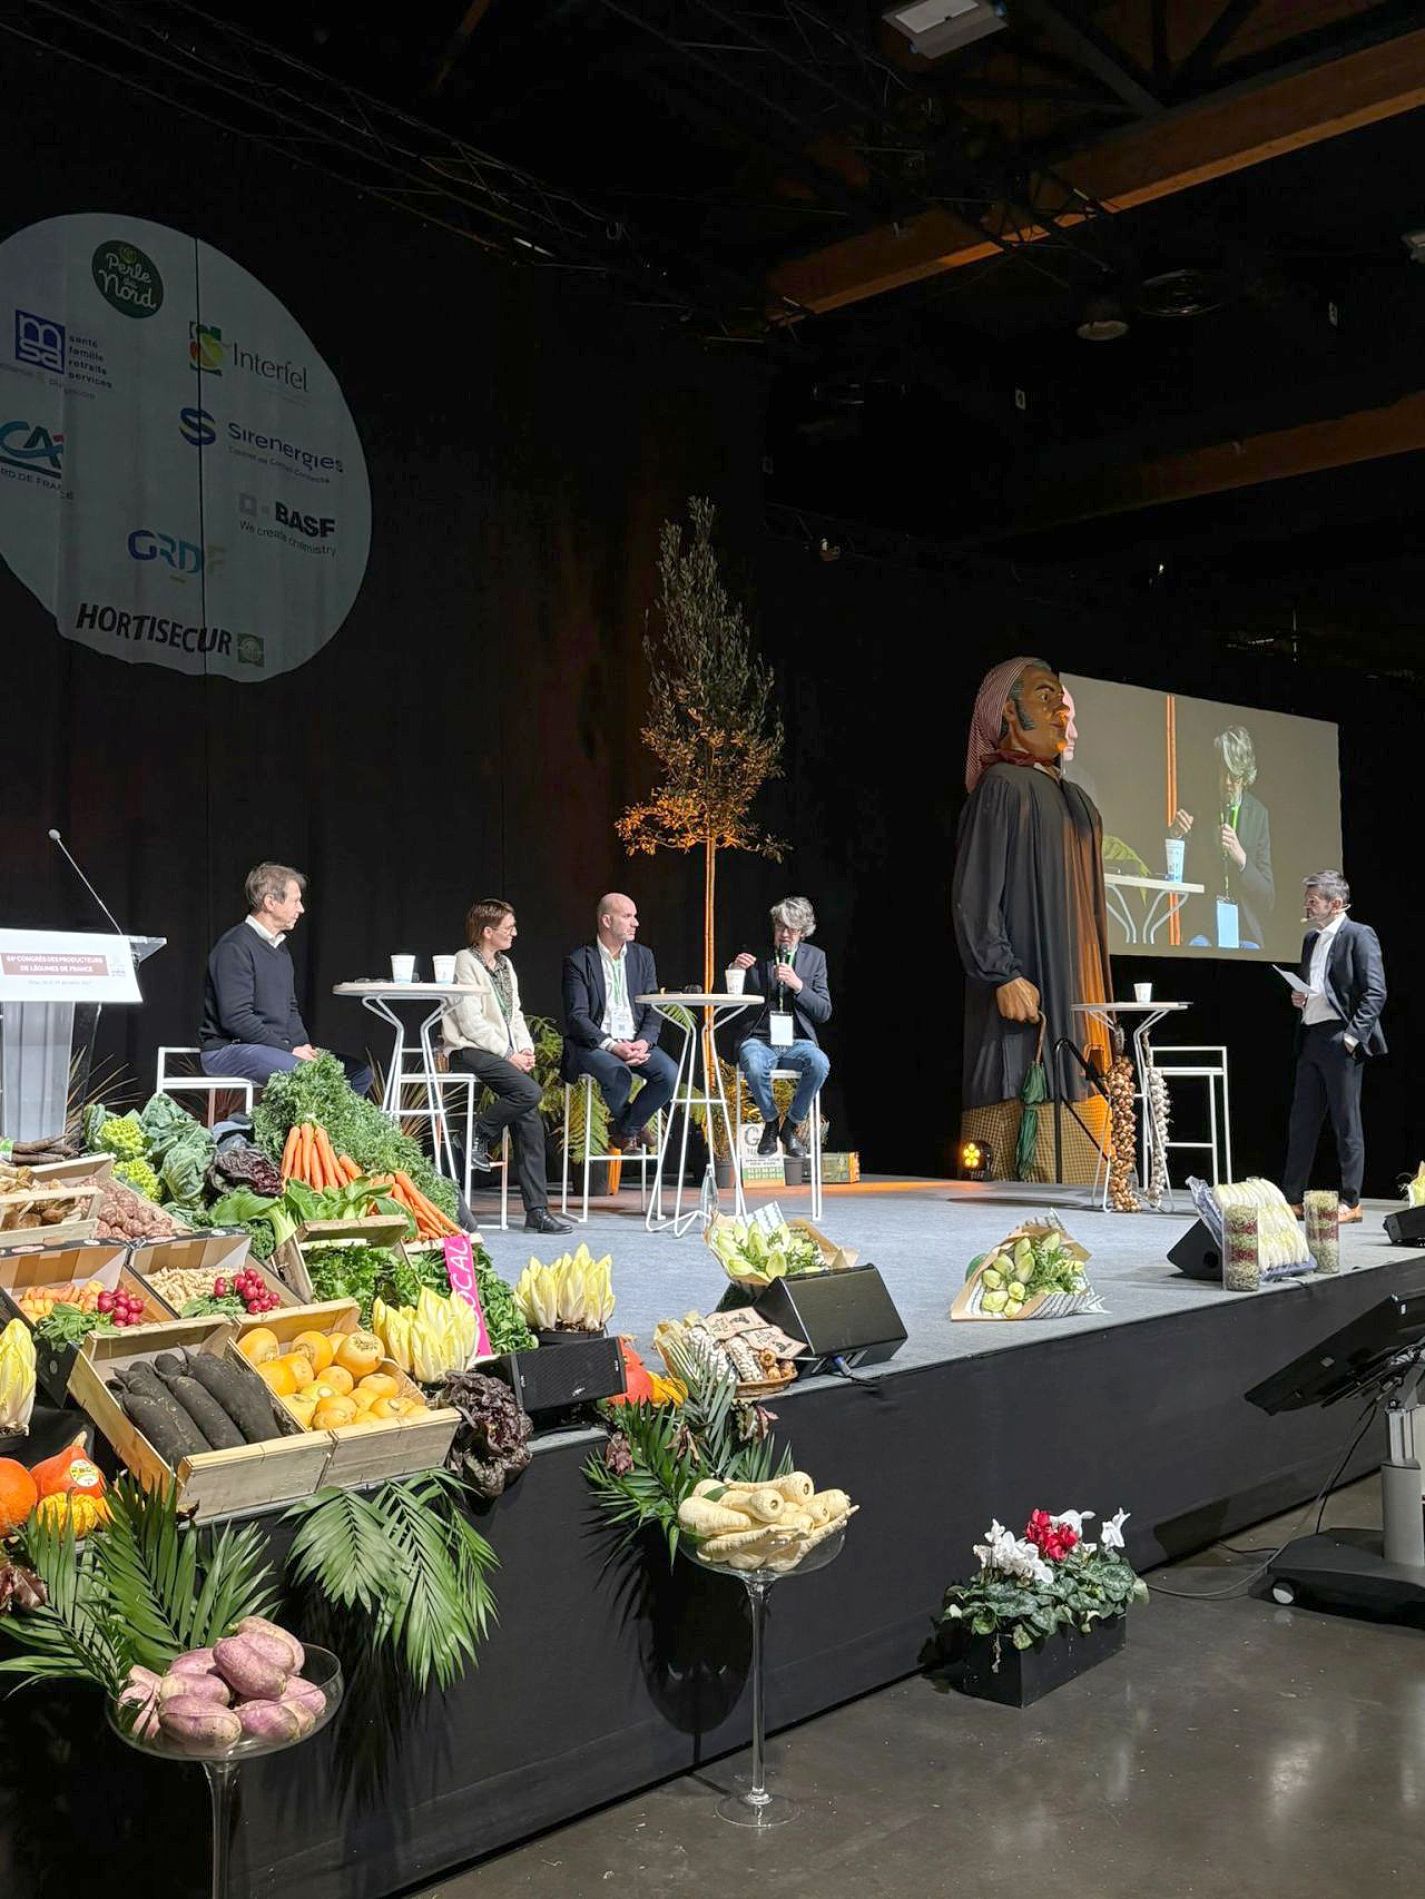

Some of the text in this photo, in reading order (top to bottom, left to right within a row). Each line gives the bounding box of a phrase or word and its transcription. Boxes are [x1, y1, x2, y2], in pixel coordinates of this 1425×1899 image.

[98, 269, 156, 309] Nord
[106, 252, 152, 283] Perle
[233, 342, 309, 393] Interfel
[228, 422, 344, 474] Sirenergies
[275, 501, 336, 538] BASF
[128, 529, 226, 578] GRDF
[76, 603, 232, 656] HORTISECUR
